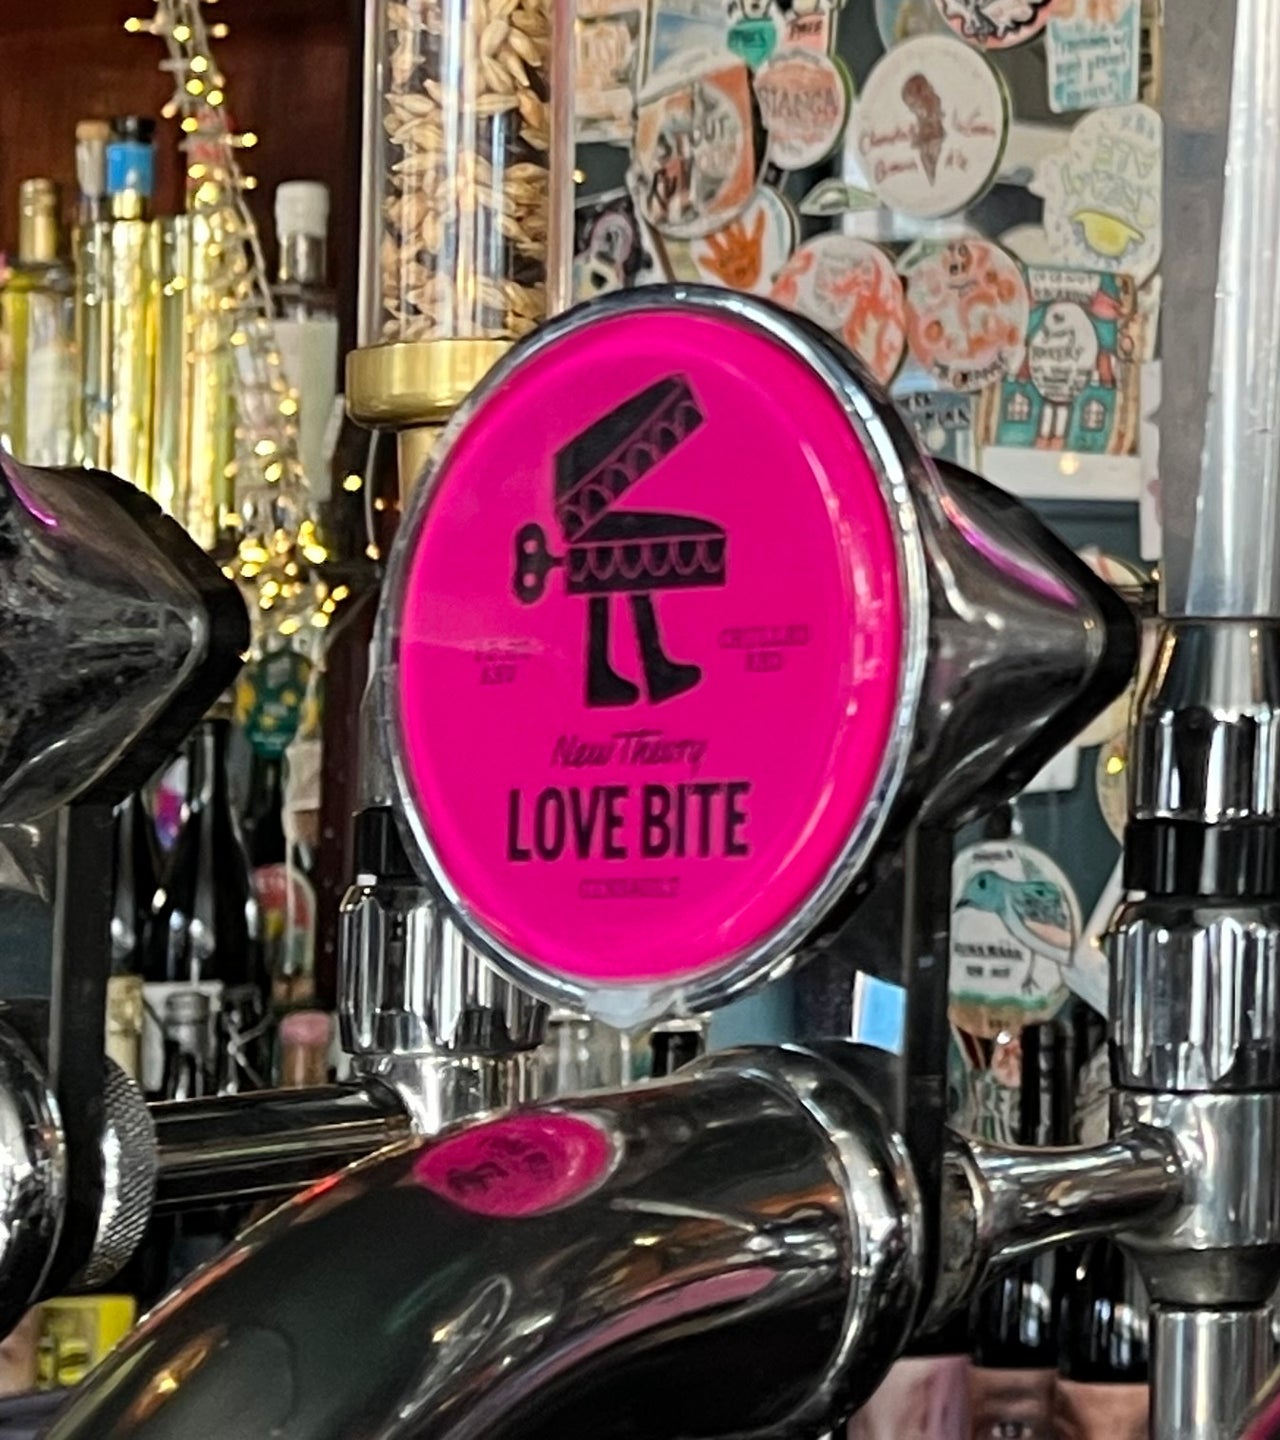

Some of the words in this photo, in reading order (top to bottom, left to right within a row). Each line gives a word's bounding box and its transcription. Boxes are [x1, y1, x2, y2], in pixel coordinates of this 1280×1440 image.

[552, 733, 613, 768] New
[612, 728, 709, 777] Theory
[508, 785, 629, 863] LOVE
[640, 779, 752, 859] BITE
